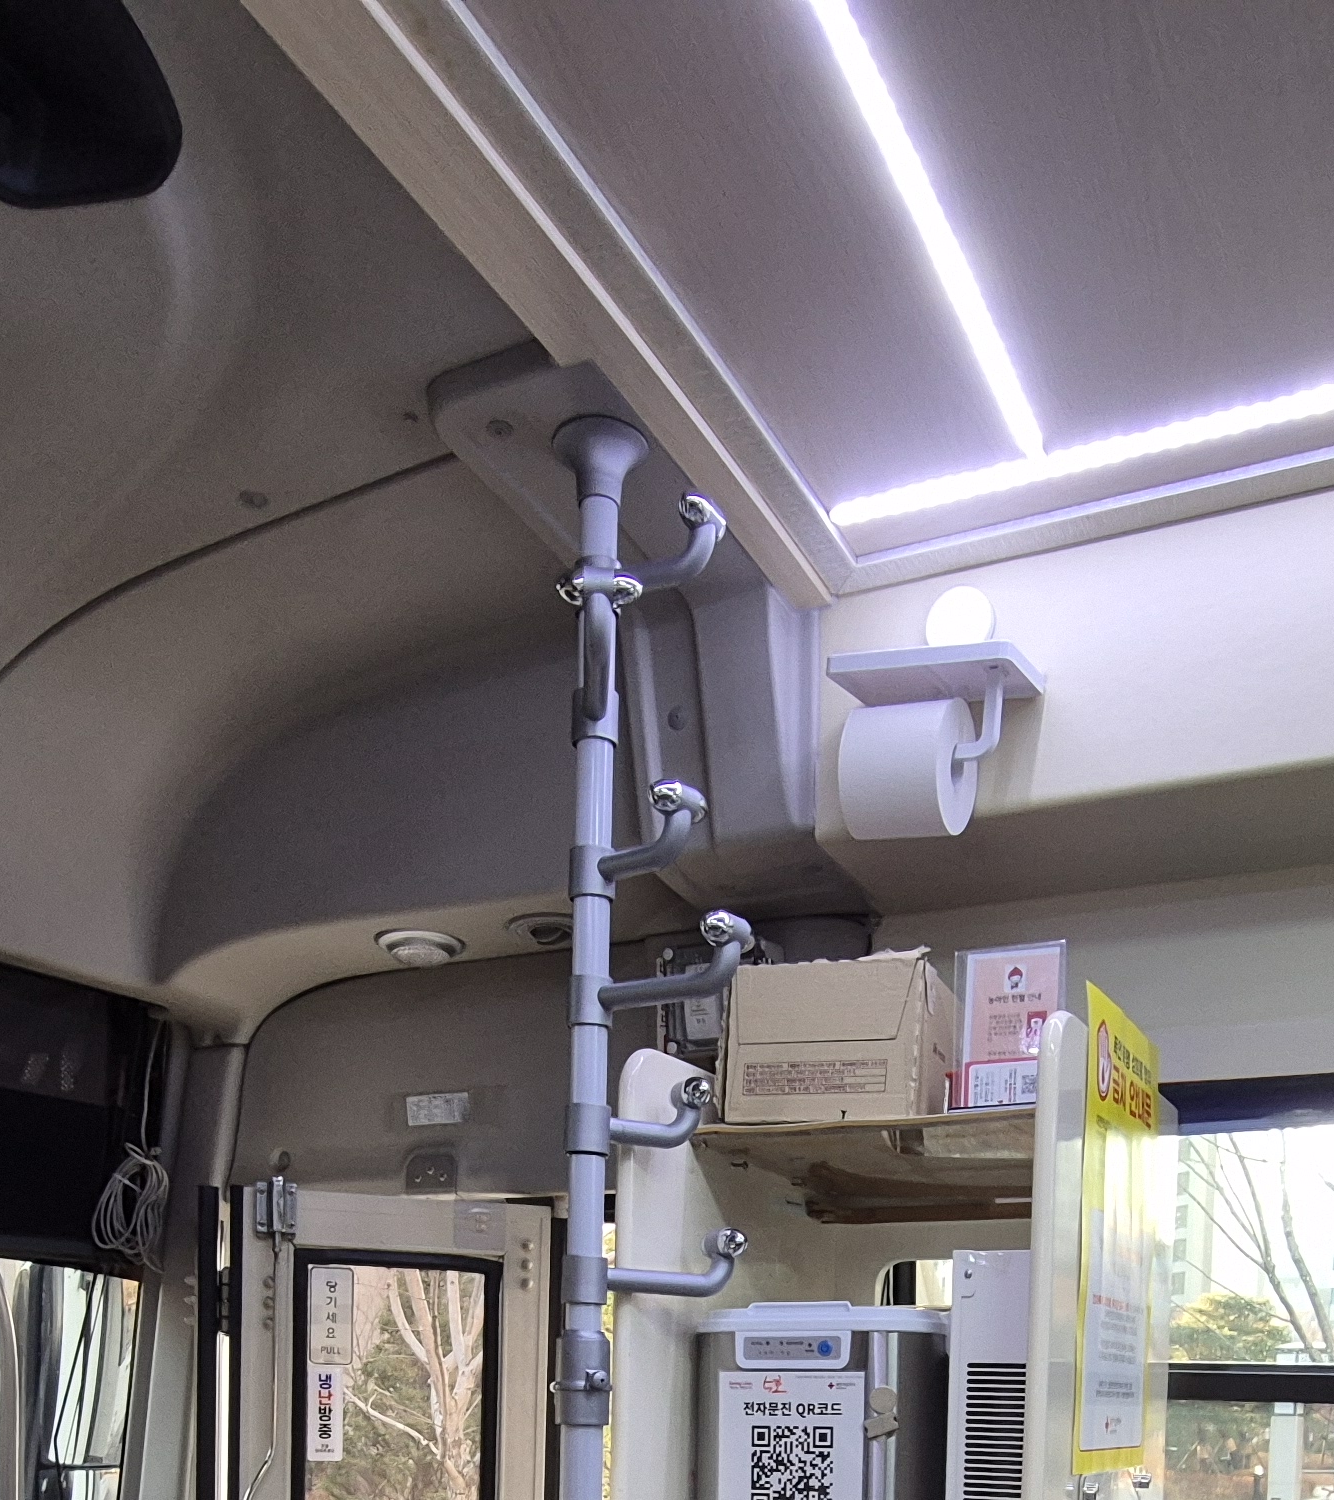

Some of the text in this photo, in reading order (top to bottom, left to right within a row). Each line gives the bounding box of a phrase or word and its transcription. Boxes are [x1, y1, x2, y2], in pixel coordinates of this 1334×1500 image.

[1112, 1064, 1152, 1130] 금지 안내문
[325, 1280, 338, 1340] 당기세요
[320, 1345, 341, 1355] PULL
[318, 1373, 333, 1440] 냉난방중
[743, 1401, 843, 1418] 전자문진 QR코드
